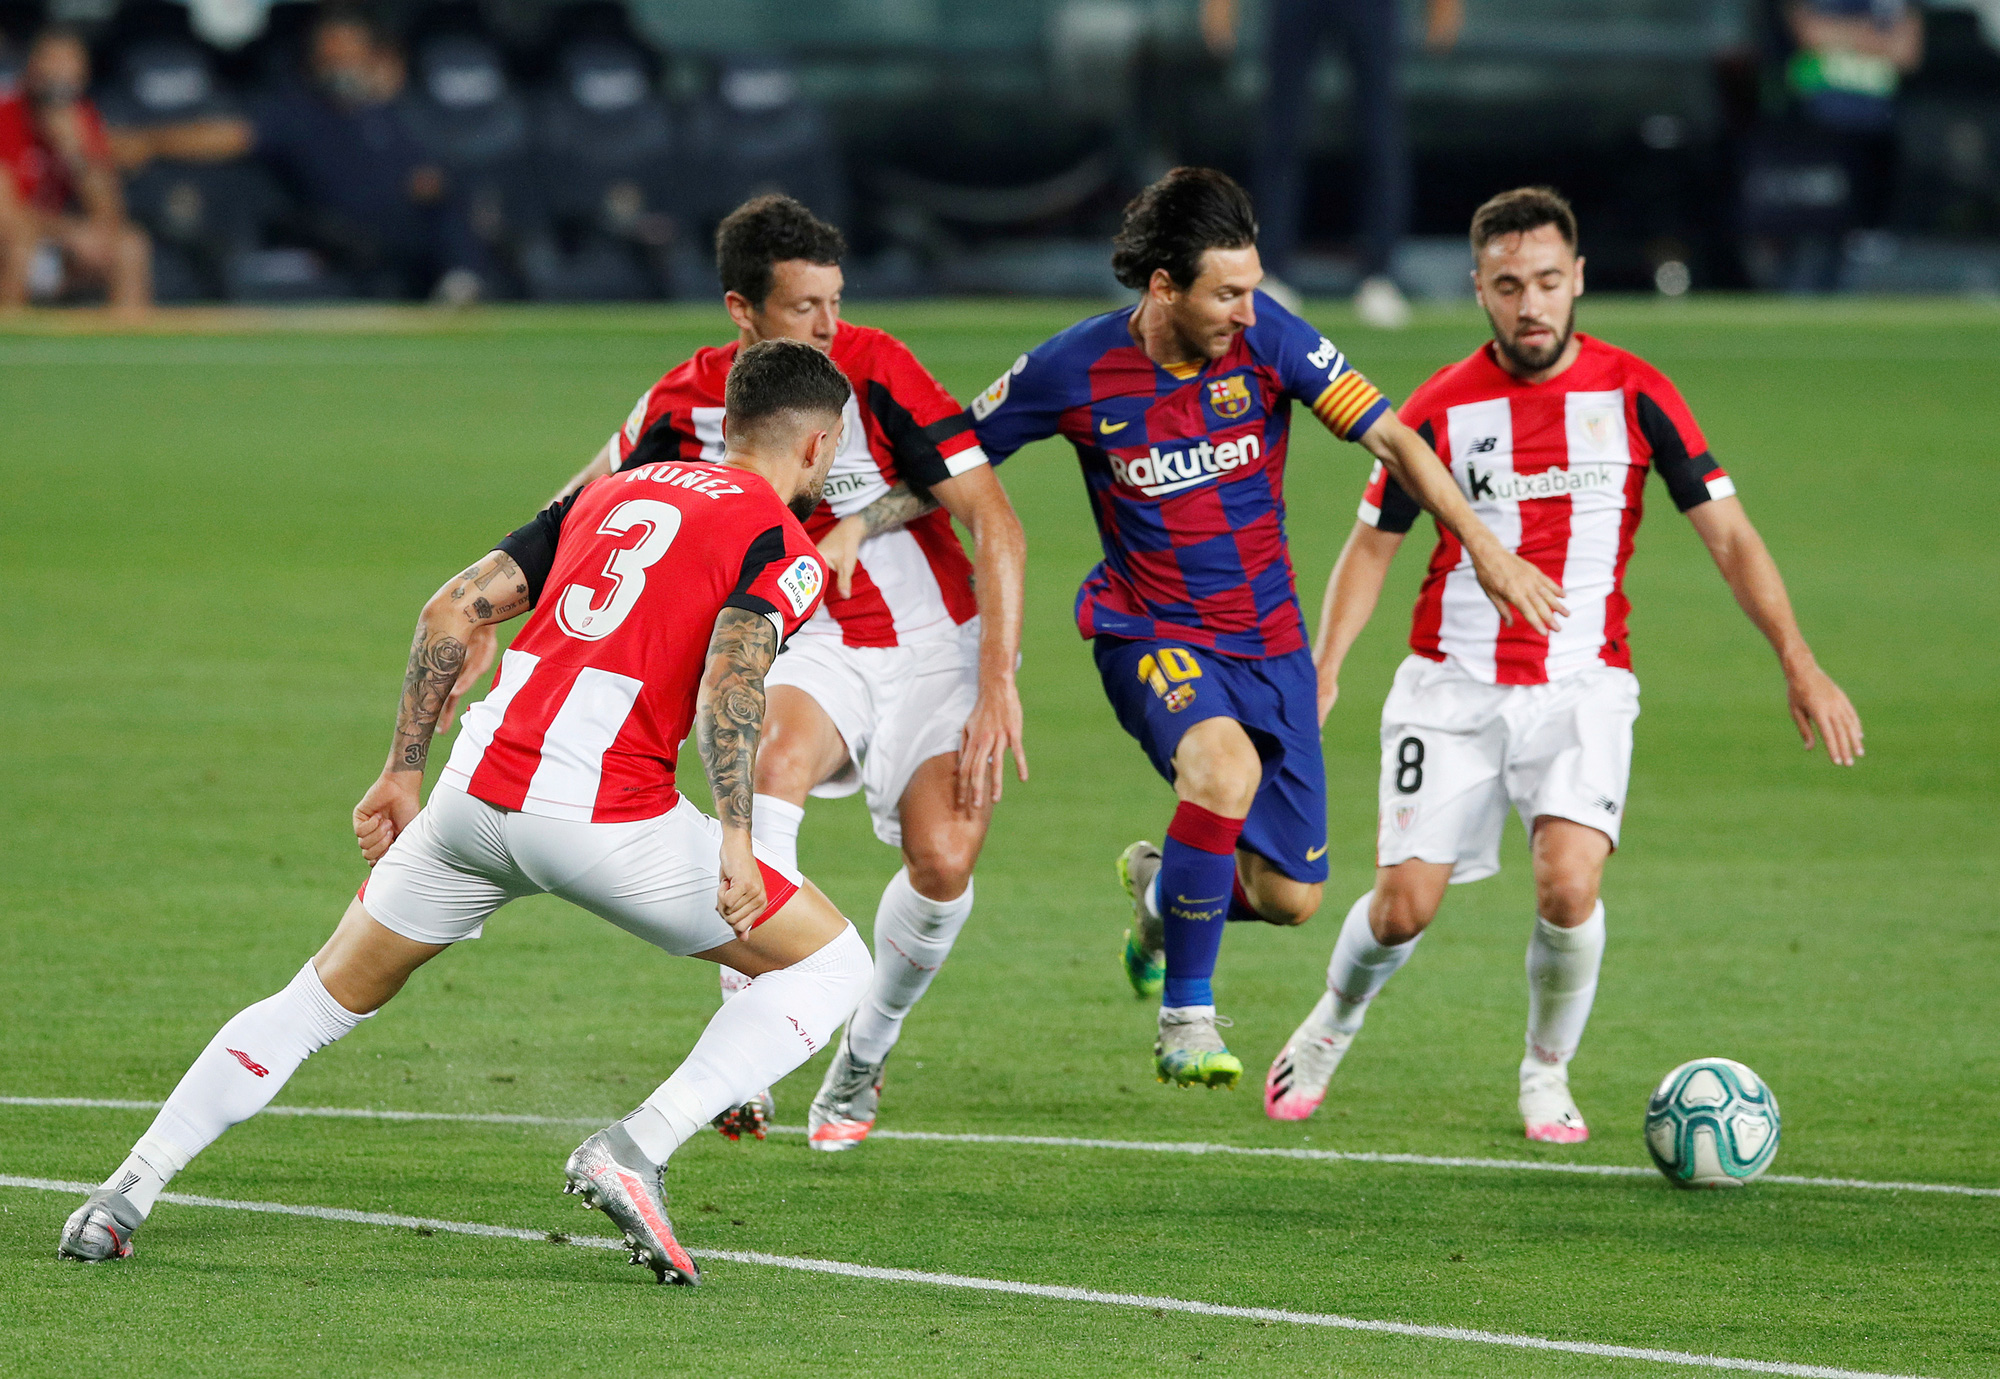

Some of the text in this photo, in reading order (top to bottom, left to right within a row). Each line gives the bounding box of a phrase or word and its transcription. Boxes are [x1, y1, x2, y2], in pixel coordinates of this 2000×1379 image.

[624, 465, 745, 500] NUÑEZ
[1109, 433, 1260, 487] Rakuten
[554, 499, 683, 642] 3
[1137, 647, 1203, 699] 10
[1396, 736, 1425, 794] 8
